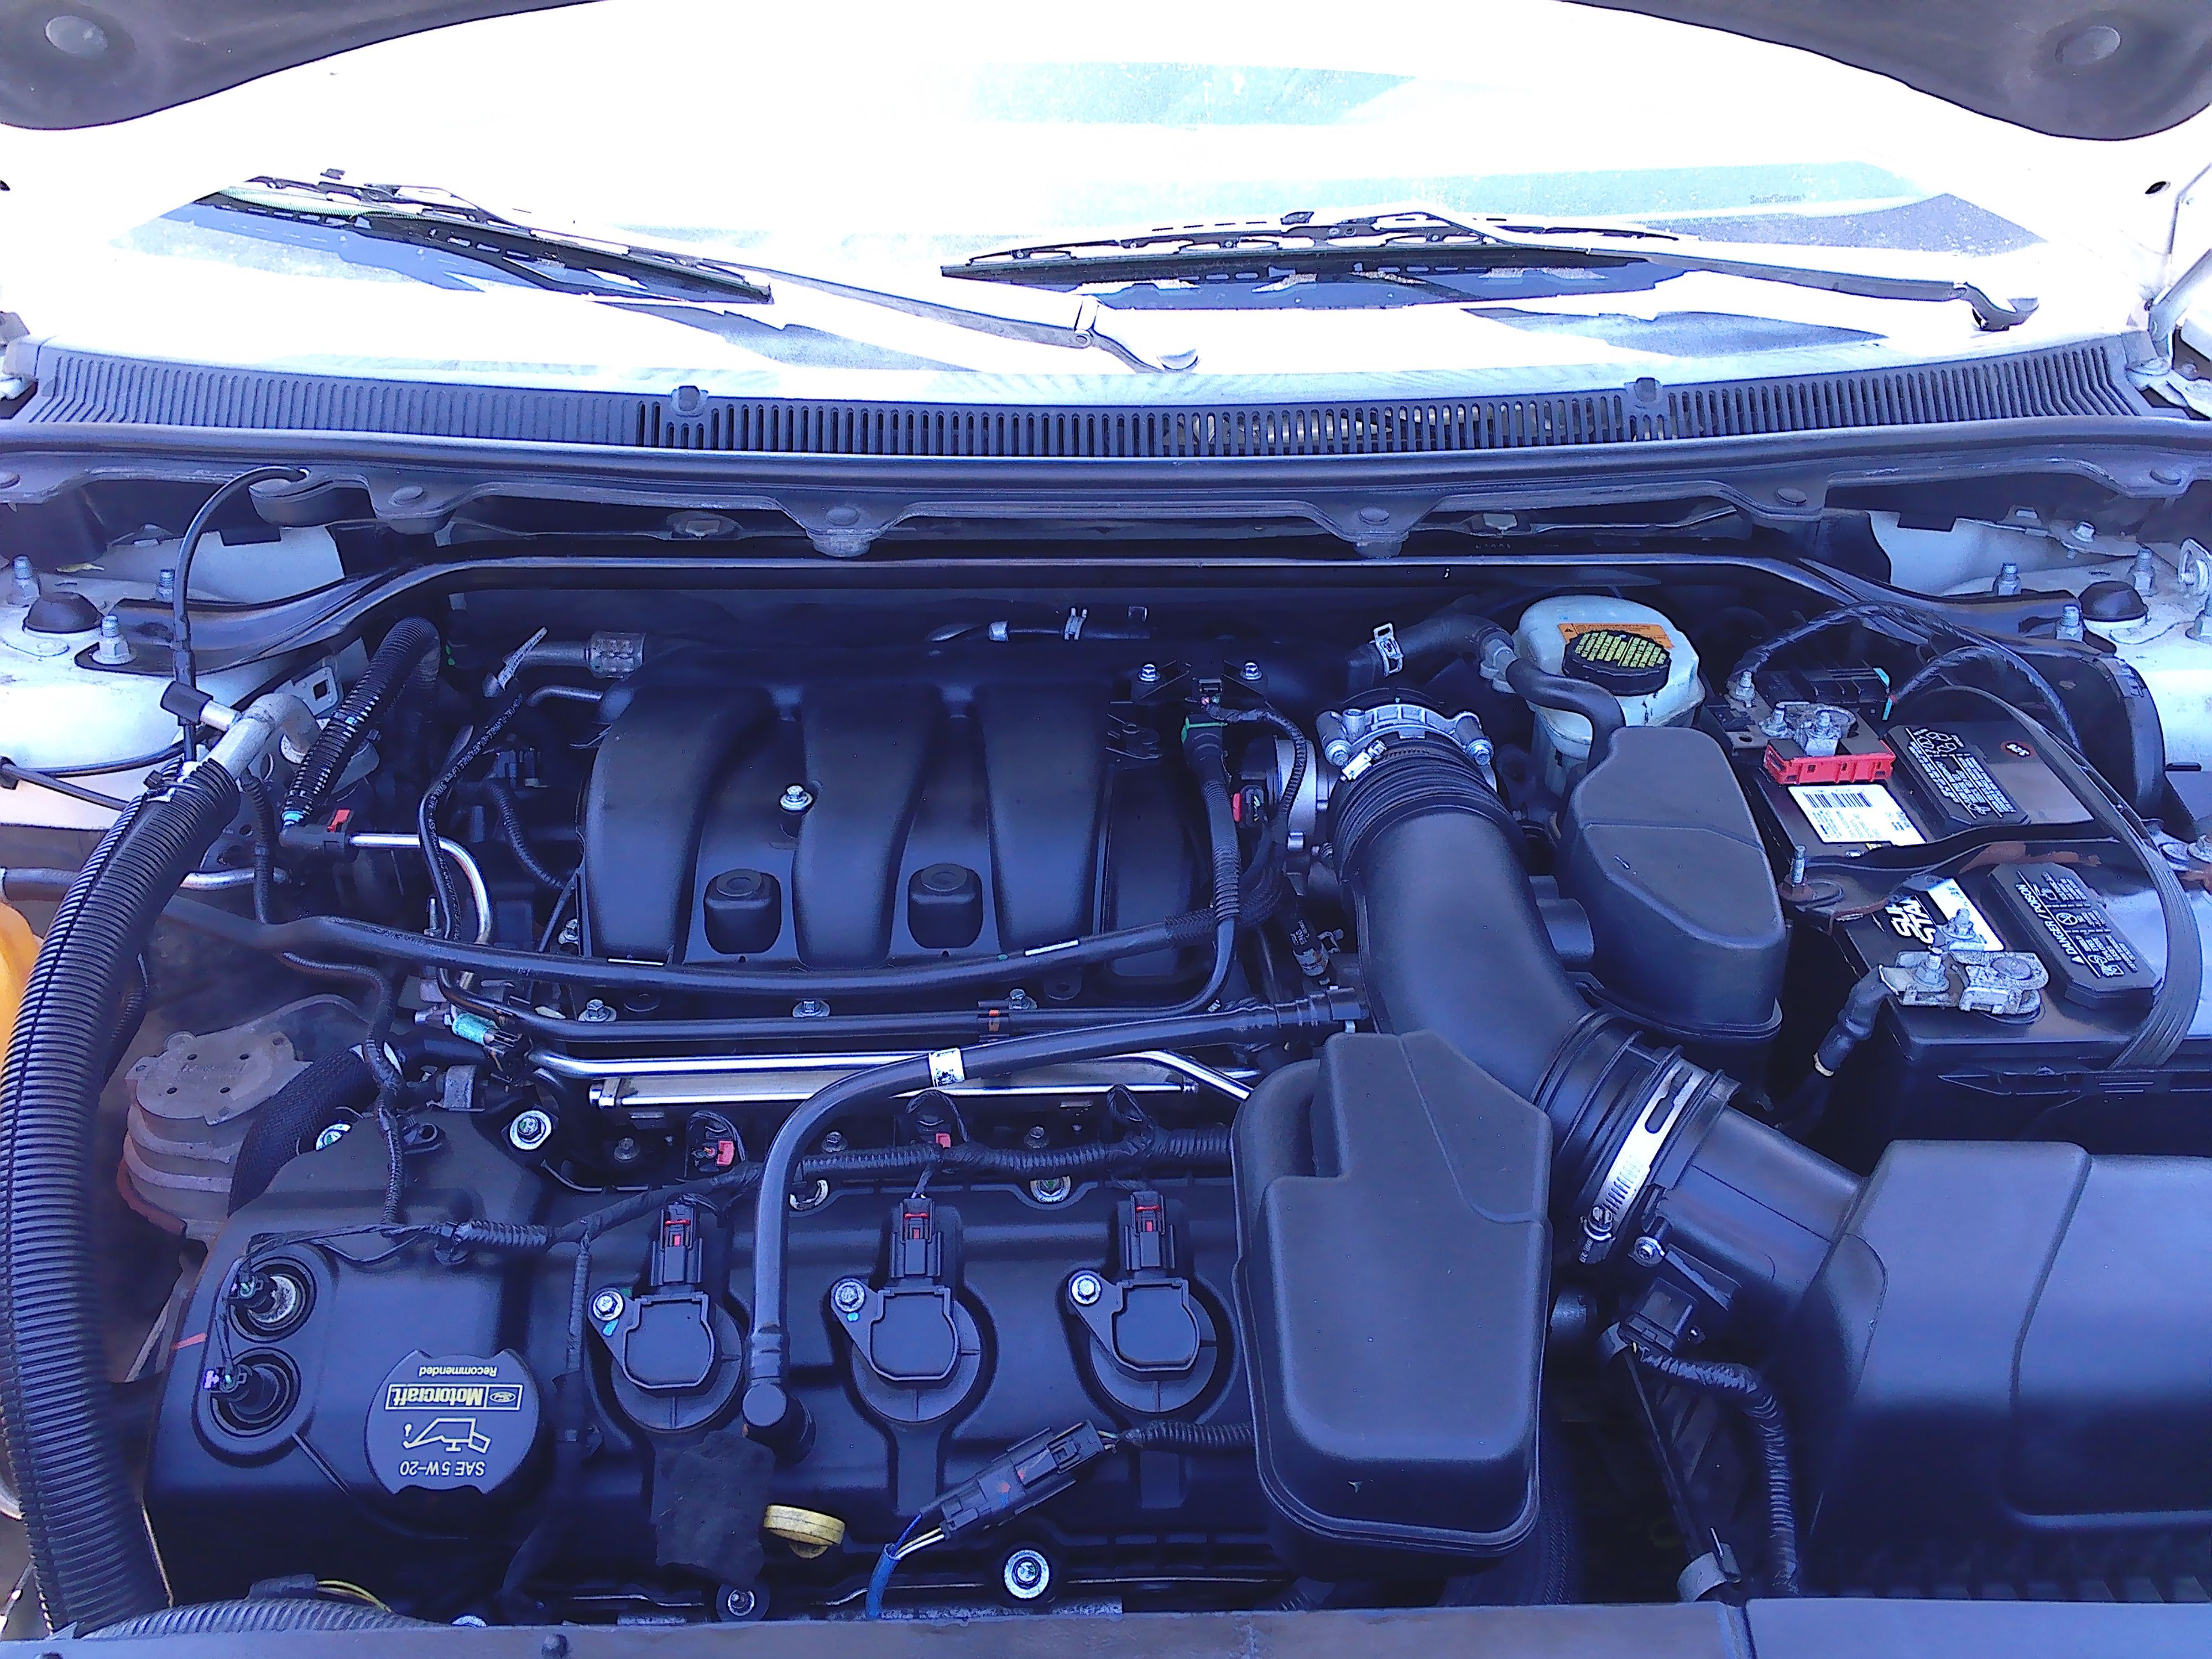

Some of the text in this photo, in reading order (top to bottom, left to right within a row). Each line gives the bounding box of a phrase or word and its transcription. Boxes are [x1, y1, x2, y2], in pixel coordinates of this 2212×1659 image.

[2016, 884, 2046, 912] POISON
[2044, 921, 2078, 954] DANGER
[419, 1366, 497, 1376] Recommended
[393, 1387, 483, 1406] Motorcraft
[400, 1460, 486, 1476] SAE 5W-20
